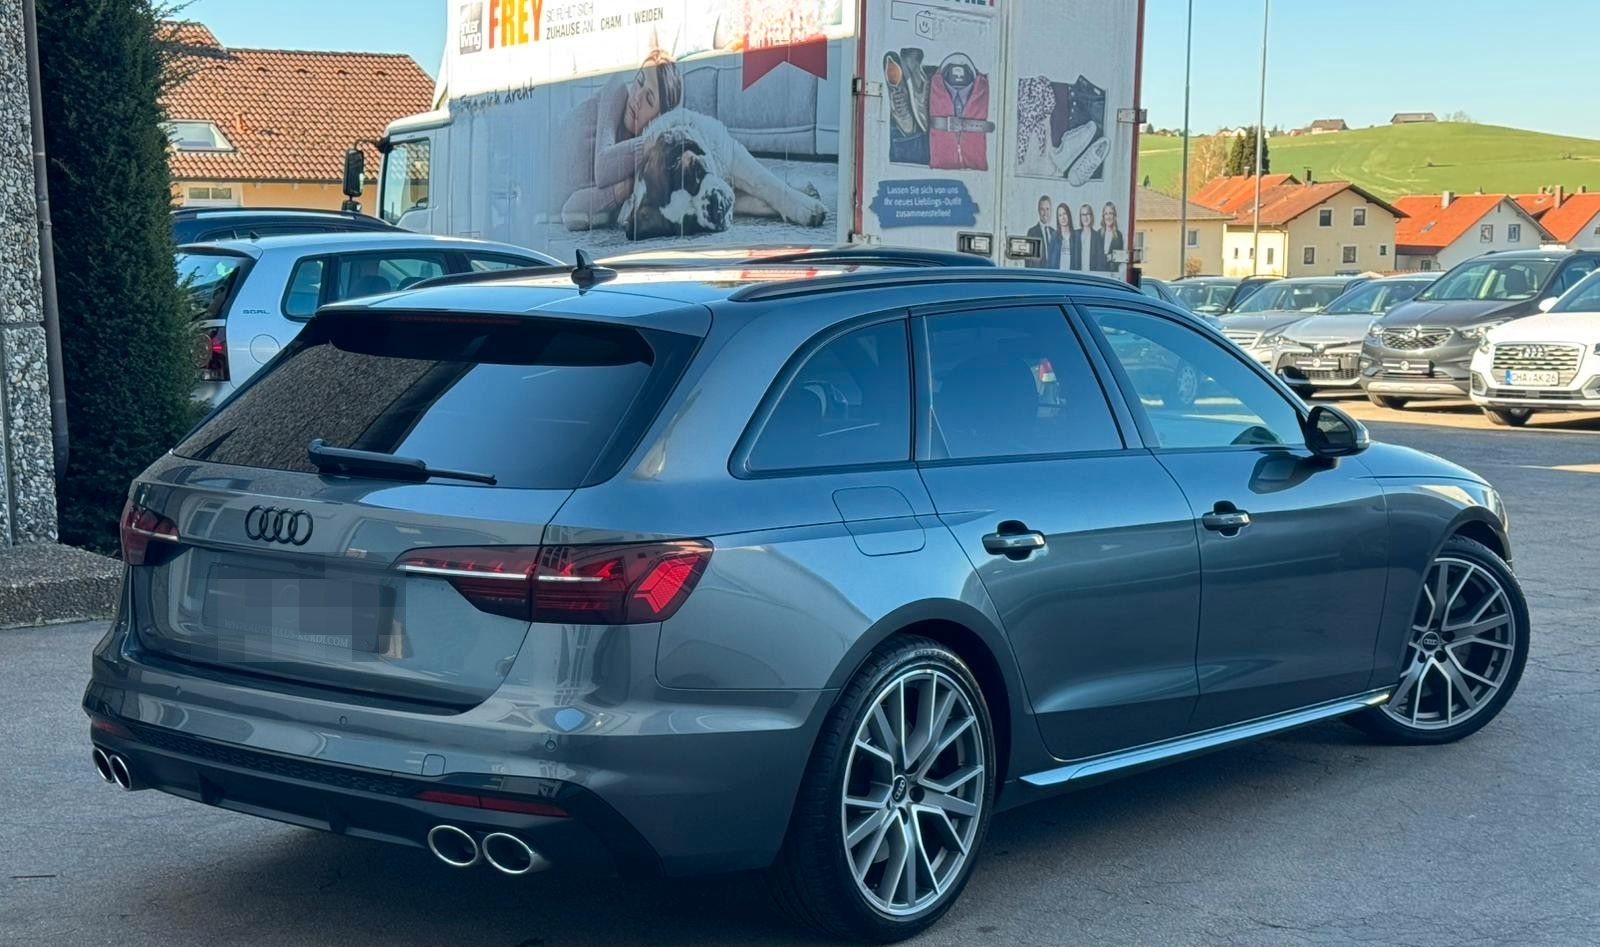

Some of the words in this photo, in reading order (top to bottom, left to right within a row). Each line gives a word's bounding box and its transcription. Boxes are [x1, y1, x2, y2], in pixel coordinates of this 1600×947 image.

[489, 0, 543, 49] FREY
[546, 21, 580, 40] ZUHAUSE
[600, 15, 622, 31] CHAM
[634, 7, 664, 24] WEIDEN
[504, 77, 535, 103] dreht
[887, 186, 908, 194] Lassen
[910, 186, 919, 195] Sie
[921, 184, 933, 194] sich
